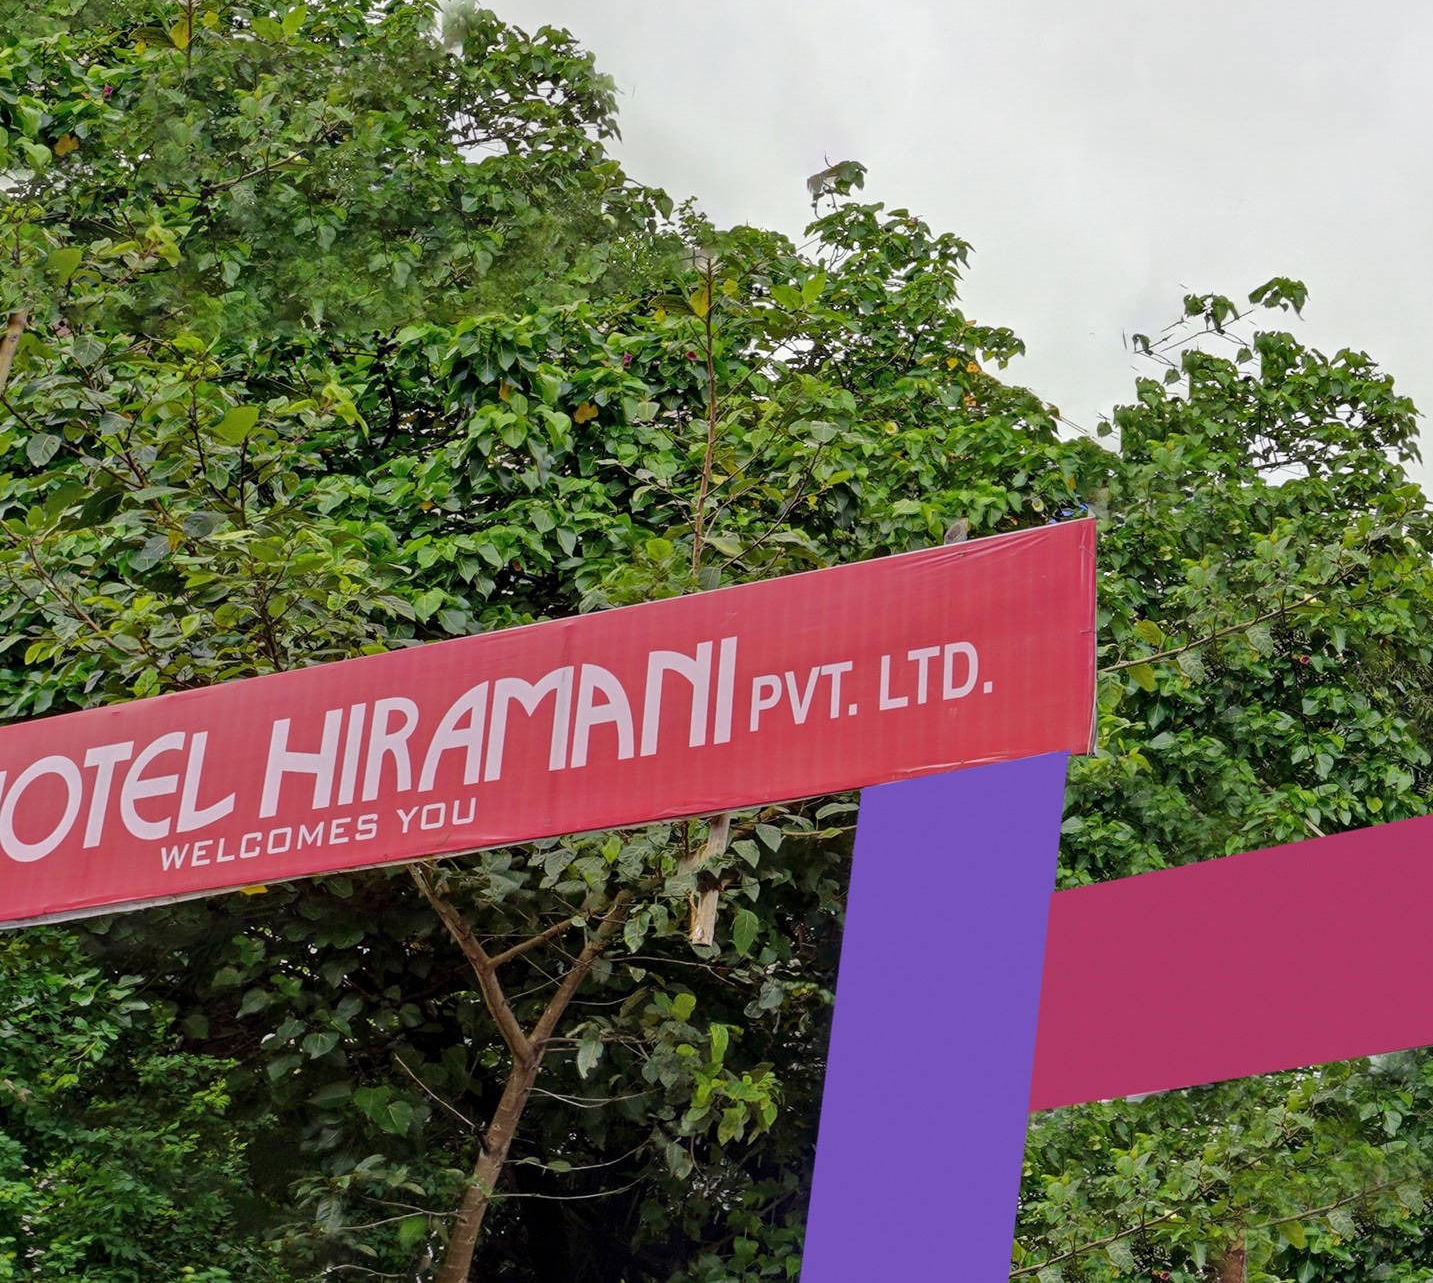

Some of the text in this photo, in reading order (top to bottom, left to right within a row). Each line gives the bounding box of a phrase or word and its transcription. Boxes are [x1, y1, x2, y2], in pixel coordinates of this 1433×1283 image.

[0, 636, 994, 864] OTEL HIRAMANI PVT. LTD.
[160, 797, 478, 872] WELCOMES YOU
